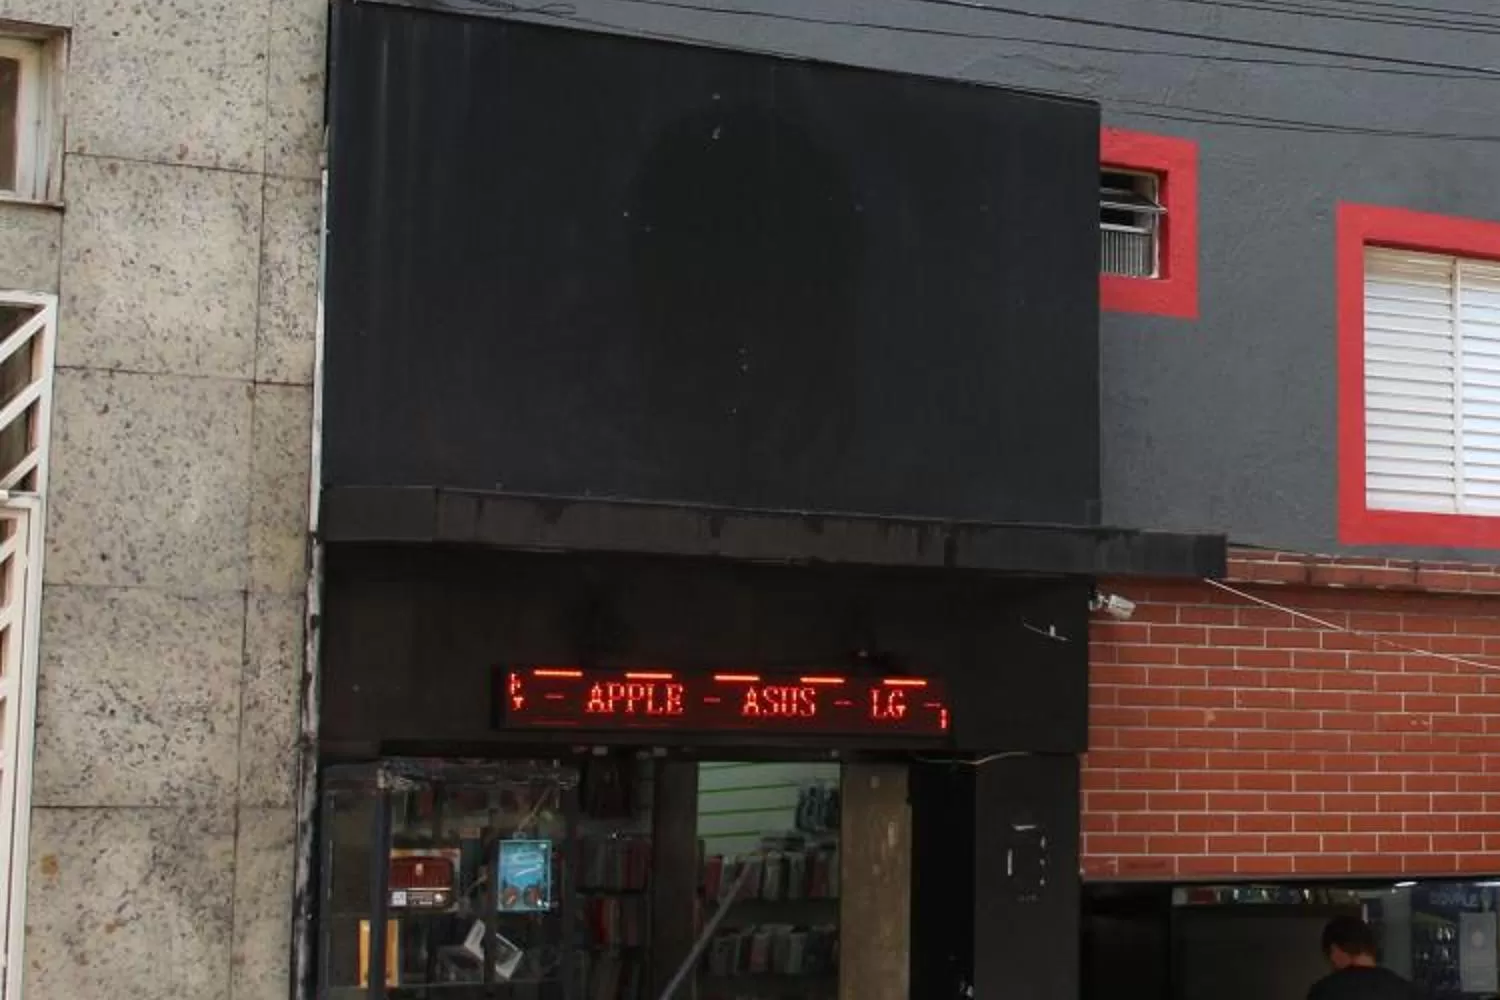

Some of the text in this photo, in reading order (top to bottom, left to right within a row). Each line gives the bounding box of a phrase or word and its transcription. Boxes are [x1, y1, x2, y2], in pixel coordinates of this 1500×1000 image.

[586, 682, 684, 714] APPLE
[742, 686, 816, 717] ASUS
[871, 689, 907, 718] LG
